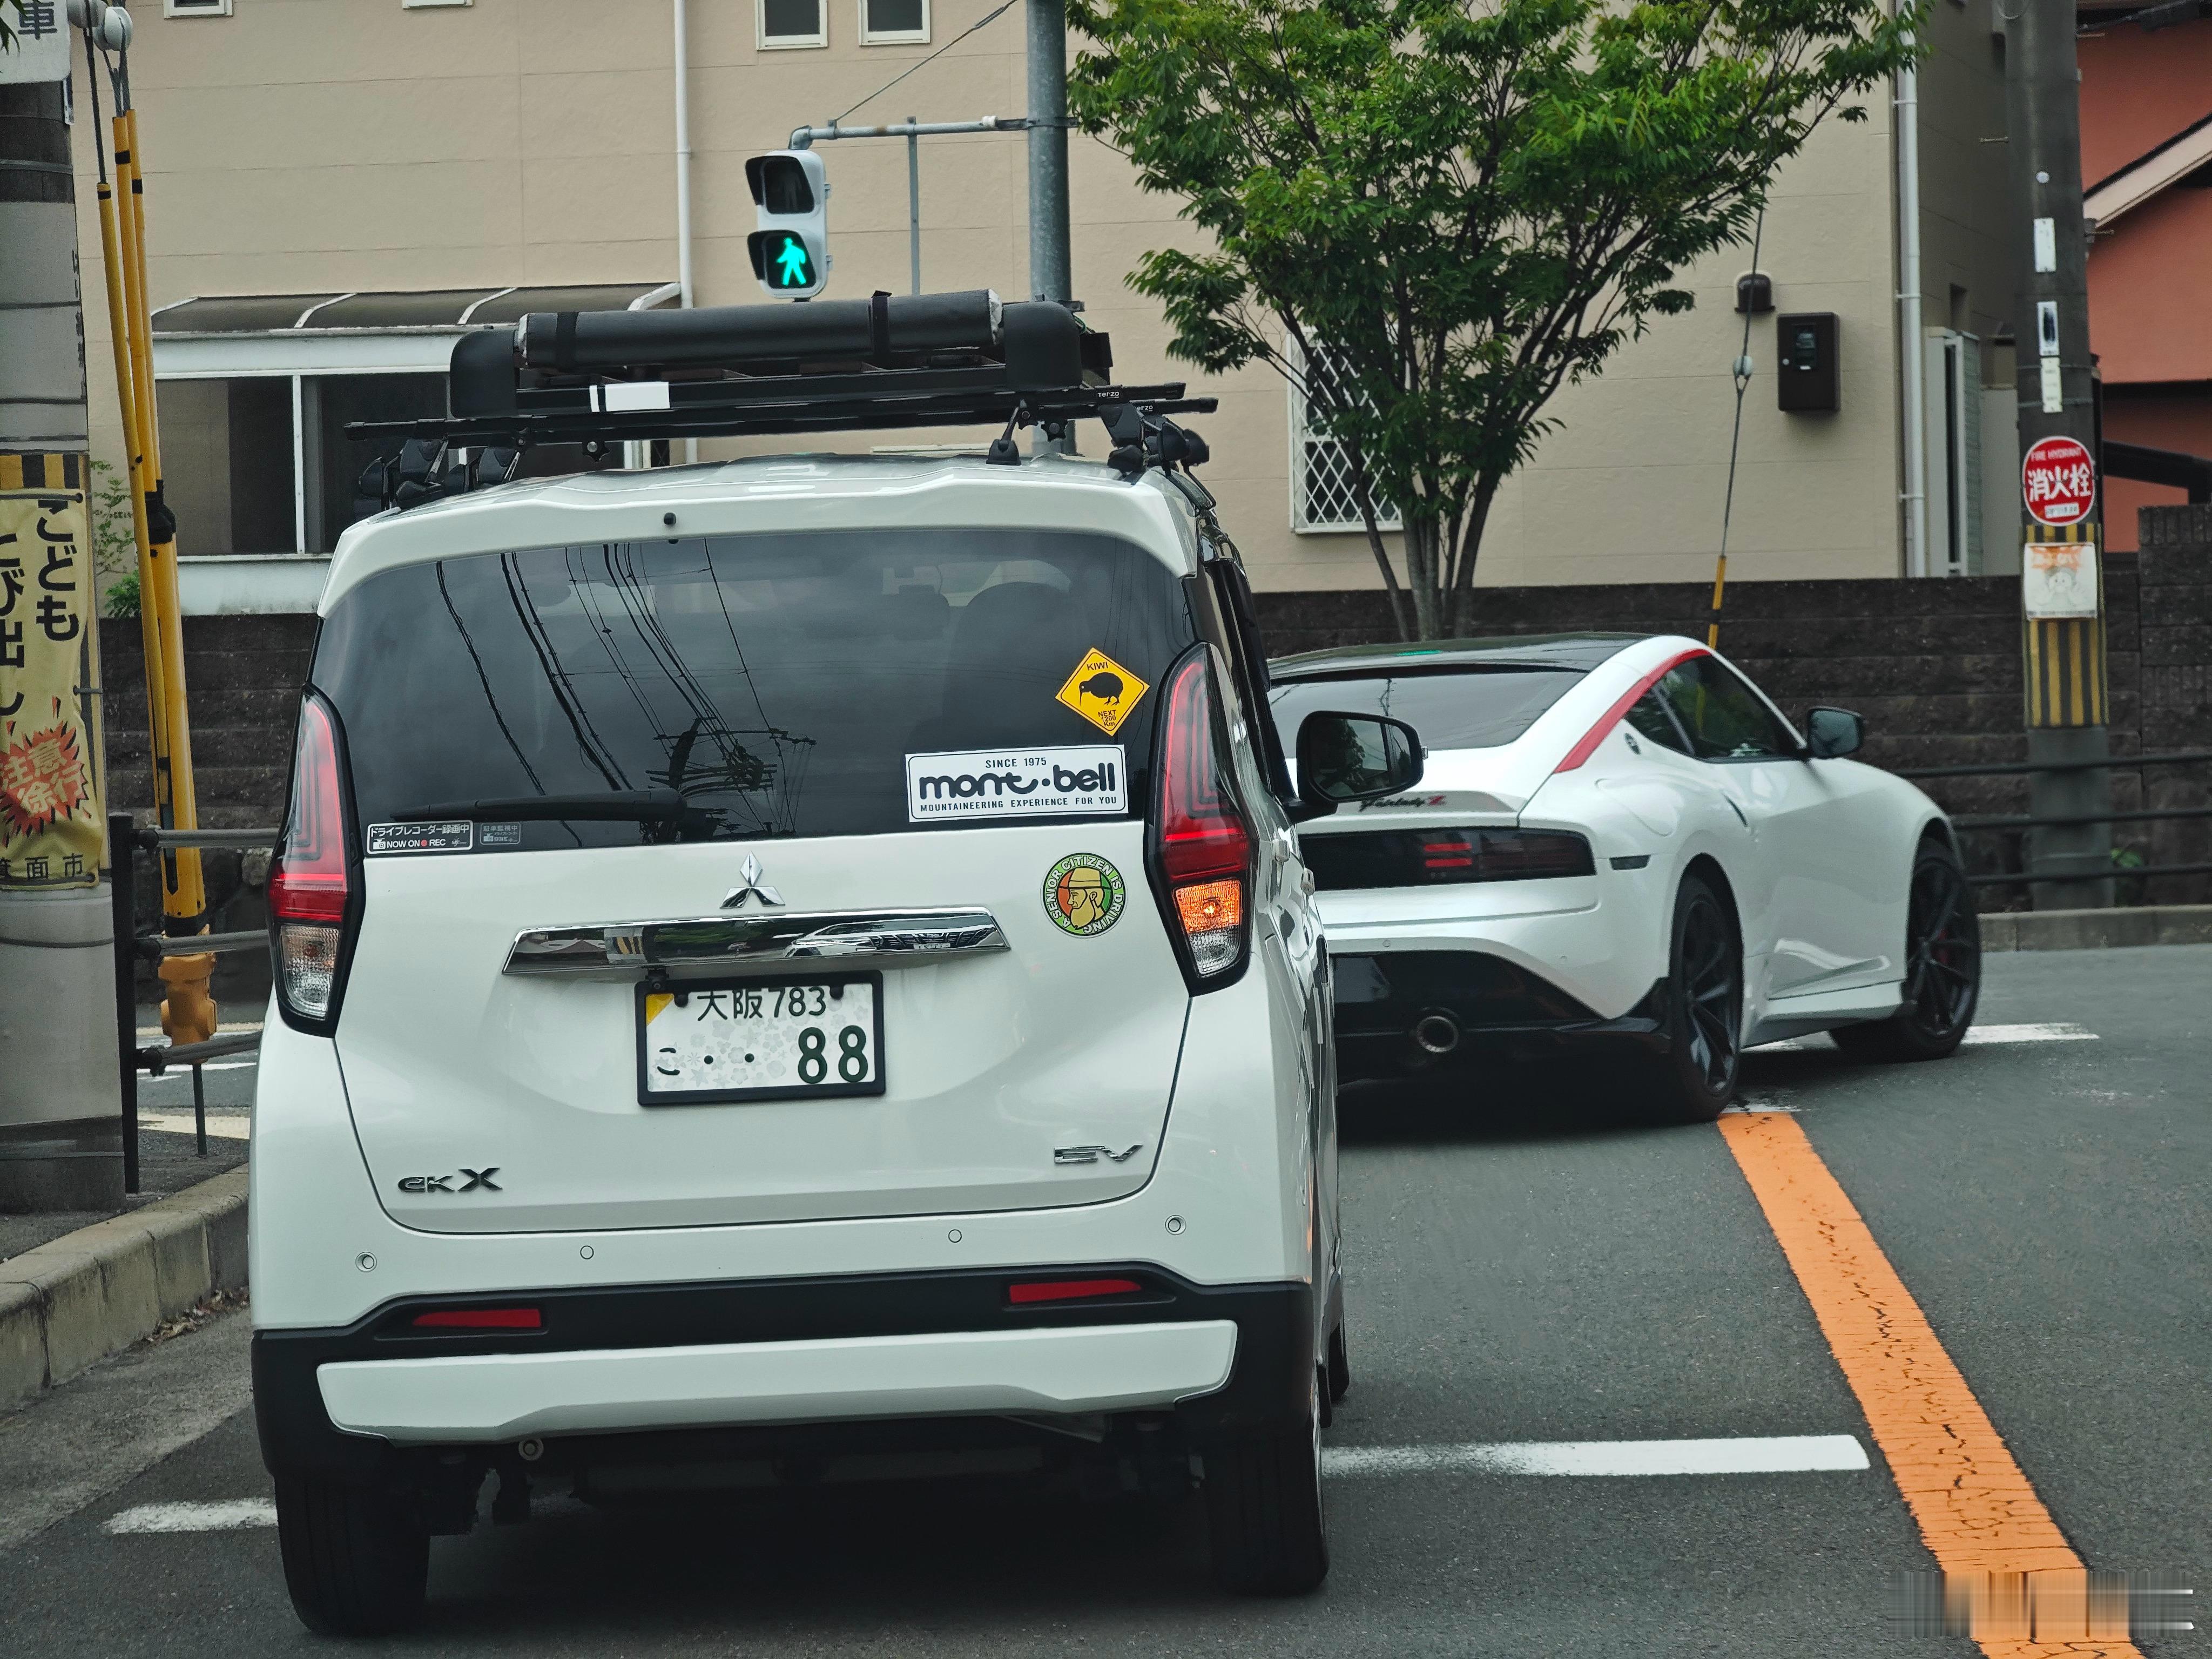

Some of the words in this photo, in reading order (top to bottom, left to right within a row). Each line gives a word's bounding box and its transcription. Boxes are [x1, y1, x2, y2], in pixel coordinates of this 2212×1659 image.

[2027, 463, 2092, 502] 消火栓
[36, 500, 80, 642] こども
[1087, 662, 1108, 671] KIWI
[985, 759, 1017, 768] SINCE
[1023, 757, 1047, 767] 1975
[920, 801, 1004, 812] MOUNTAINEERING
[1010, 798, 1069, 808] EXPERIENCE
[1075, 797, 1094, 805] FOR
[1098, 796, 1117, 805] YOU
[370, 824, 470, 838] ドライブレコーダー録画中
[387, 840, 407, 848] NOW
[408, 839, 421, 848] ON
[429, 838, 447, 847] REC
[1061, 855, 1114, 876] CITIZEN
[1109, 875, 1123, 891] IS
[1046, 869, 1063, 919] SENIOR
[1083, 893, 1124, 934] DRIVING
[1062, 917, 1072, 928] A
[1054, 1144, 1144, 1163] EV
